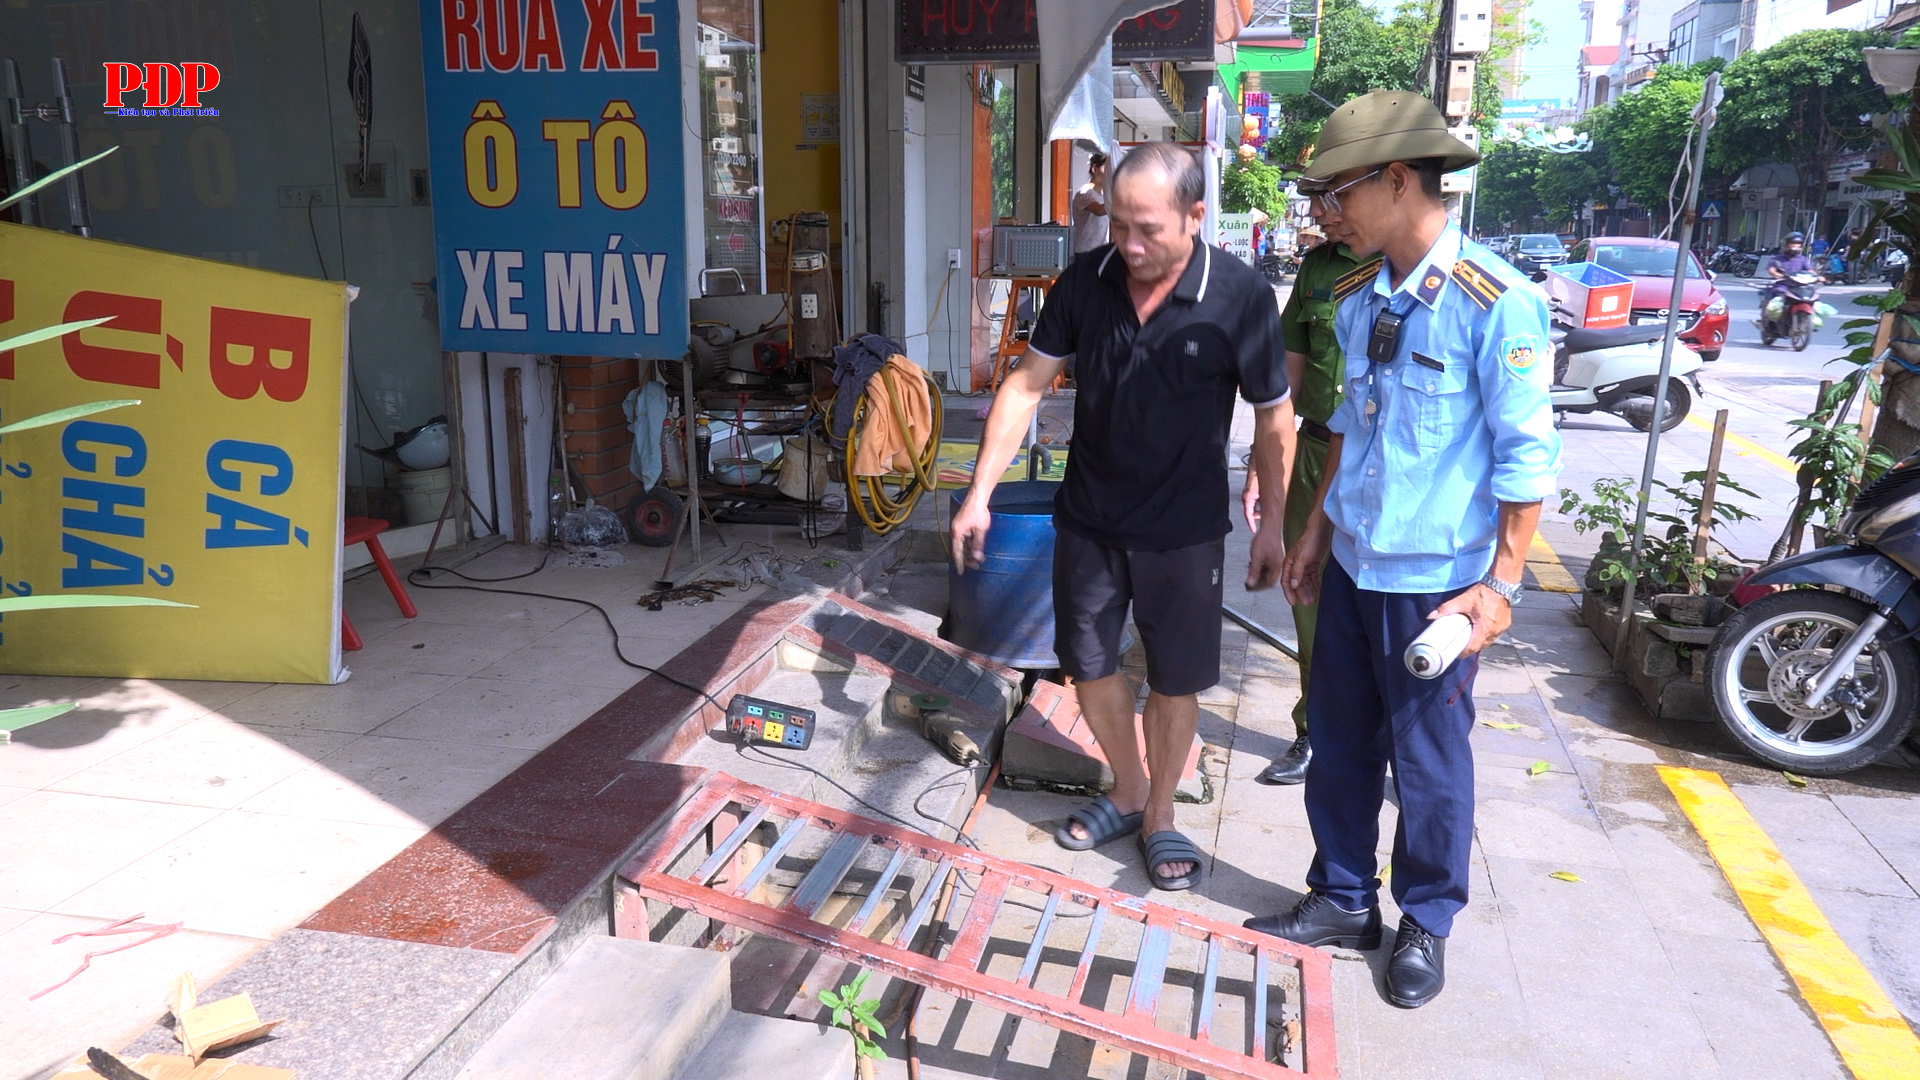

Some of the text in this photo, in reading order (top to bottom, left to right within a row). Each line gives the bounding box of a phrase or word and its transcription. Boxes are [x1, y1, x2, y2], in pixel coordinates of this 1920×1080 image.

[580, 0, 659, 71] XE
[922, 0, 1001, 36] HUY
[463, 100, 649, 211] Ô TÔ
[1218, 219, 1249, 230] Xuân
[455, 234, 668, 335] XE MÁY
[61, 420, 175, 588] CHẢ
[205, 439, 310, 549] CÁ
